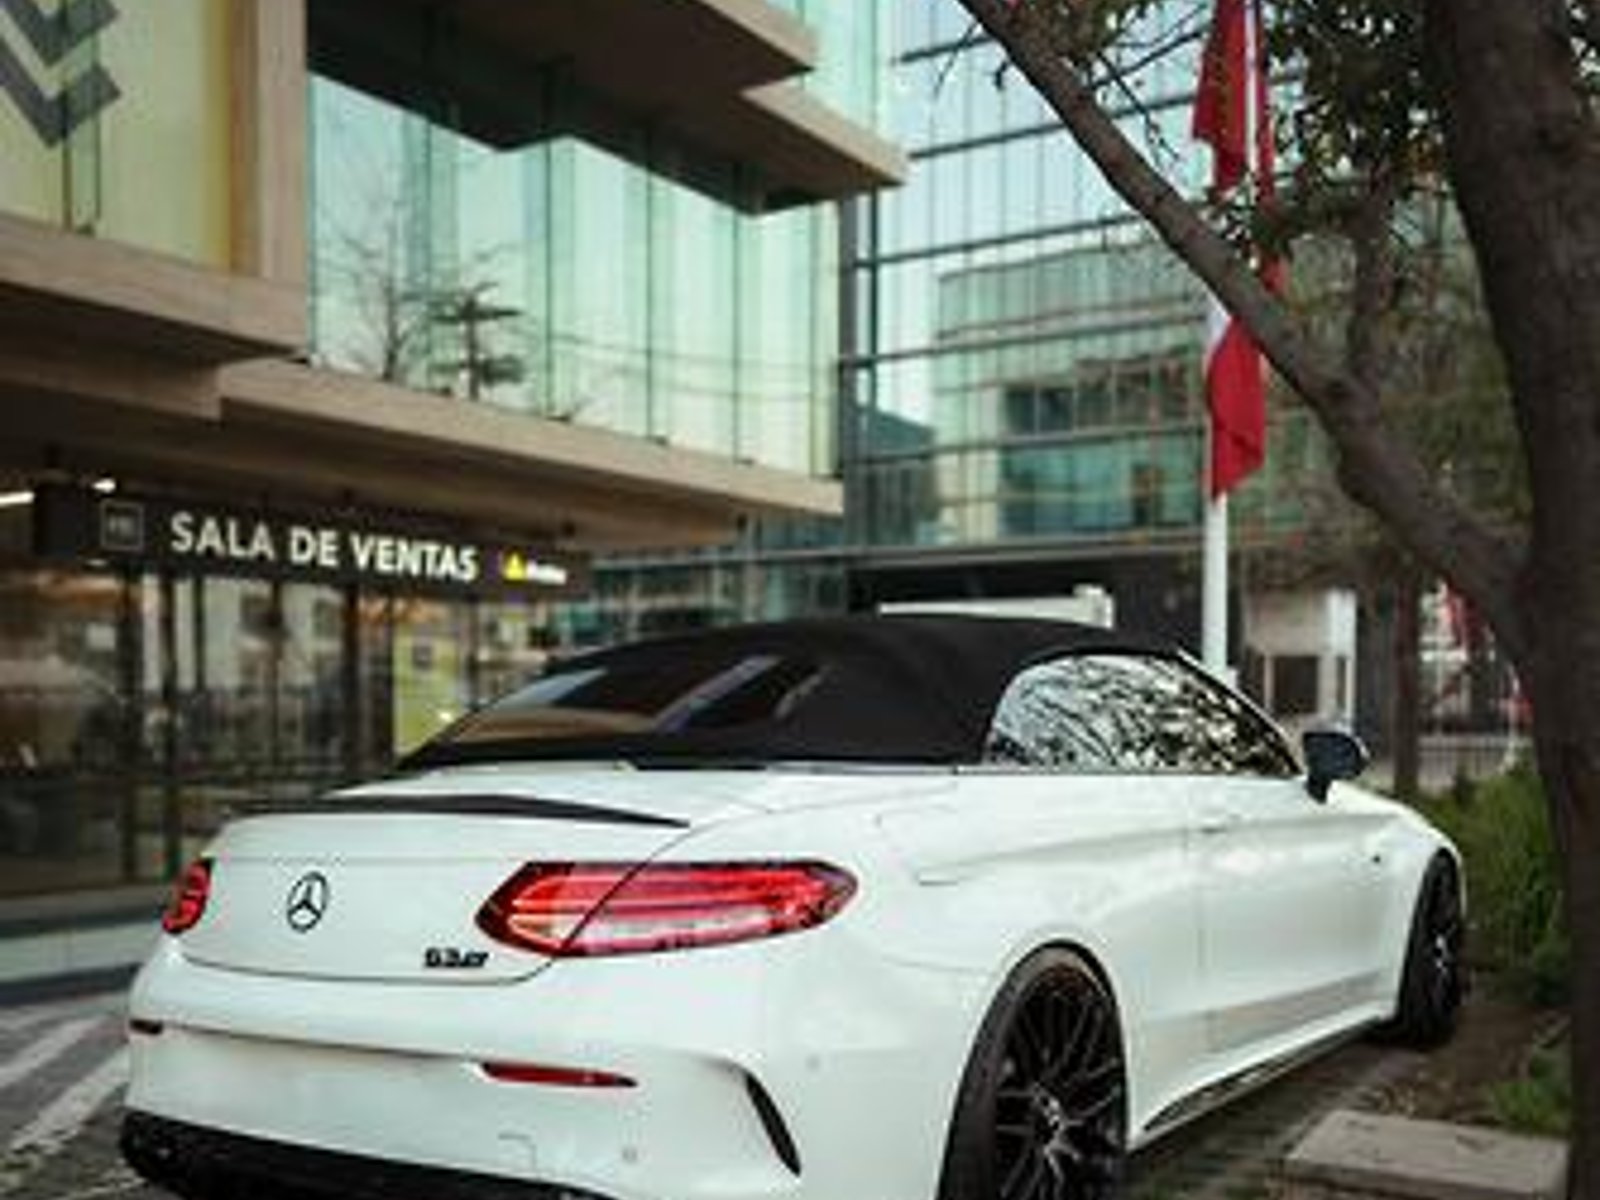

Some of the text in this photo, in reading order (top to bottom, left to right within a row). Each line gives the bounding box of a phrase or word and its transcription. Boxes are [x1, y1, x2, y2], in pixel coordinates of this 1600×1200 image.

[170, 510, 276, 561] SALA
[289, 526, 339, 568] DE
[350, 533, 478, 582] VENTAS
